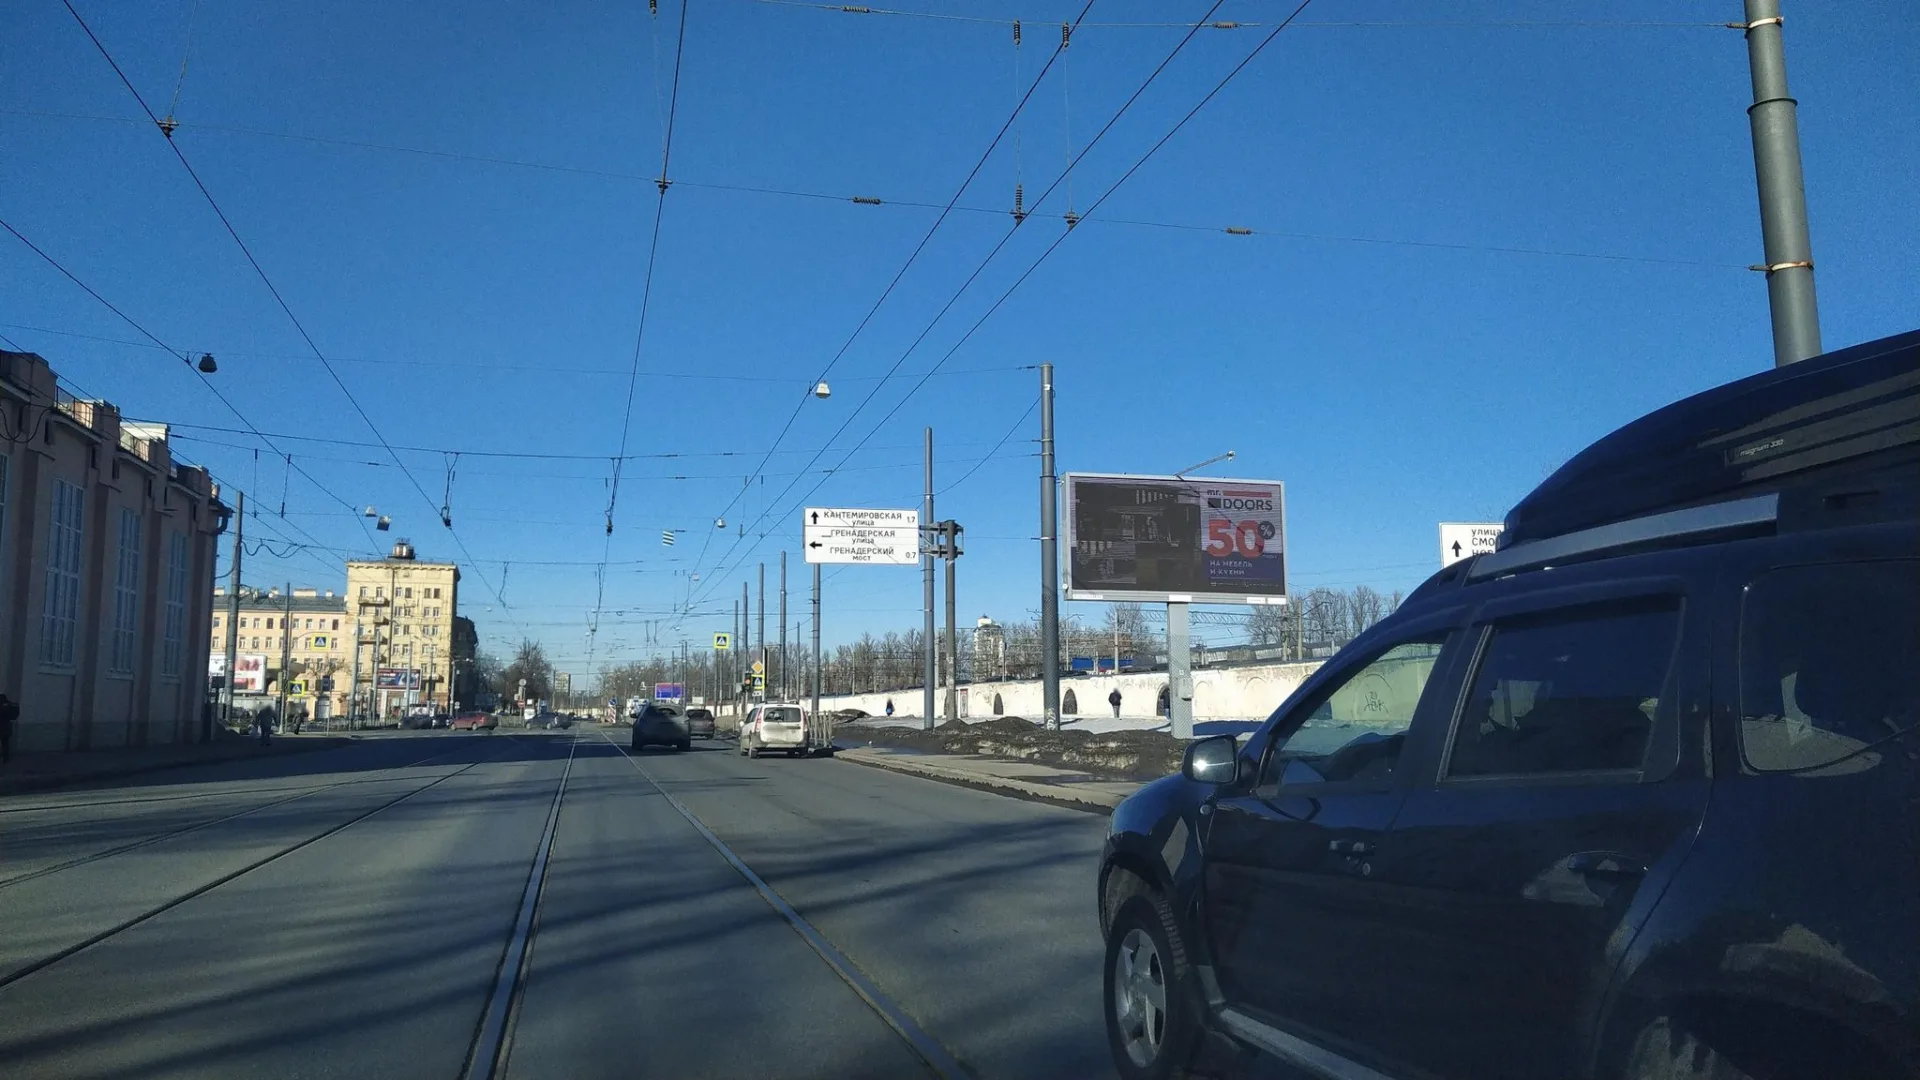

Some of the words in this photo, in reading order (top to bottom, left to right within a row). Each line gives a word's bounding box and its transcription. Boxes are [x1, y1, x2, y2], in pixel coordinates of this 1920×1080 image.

[1223, 498, 1273, 511] DOORS
[824, 511, 902, 520] КАНТЕМИРОВСКАЯ
[830, 529, 896, 538] ГРЕНАДЕРСКАЯ
[1471, 537, 1496, 547] СМО
[829, 546, 894, 555] ГРЕНАДЕРСКИЙ
[905, 551, 917, 559] 0.7
[1222, 560, 1253, 568] МЕБЕЛЬ
